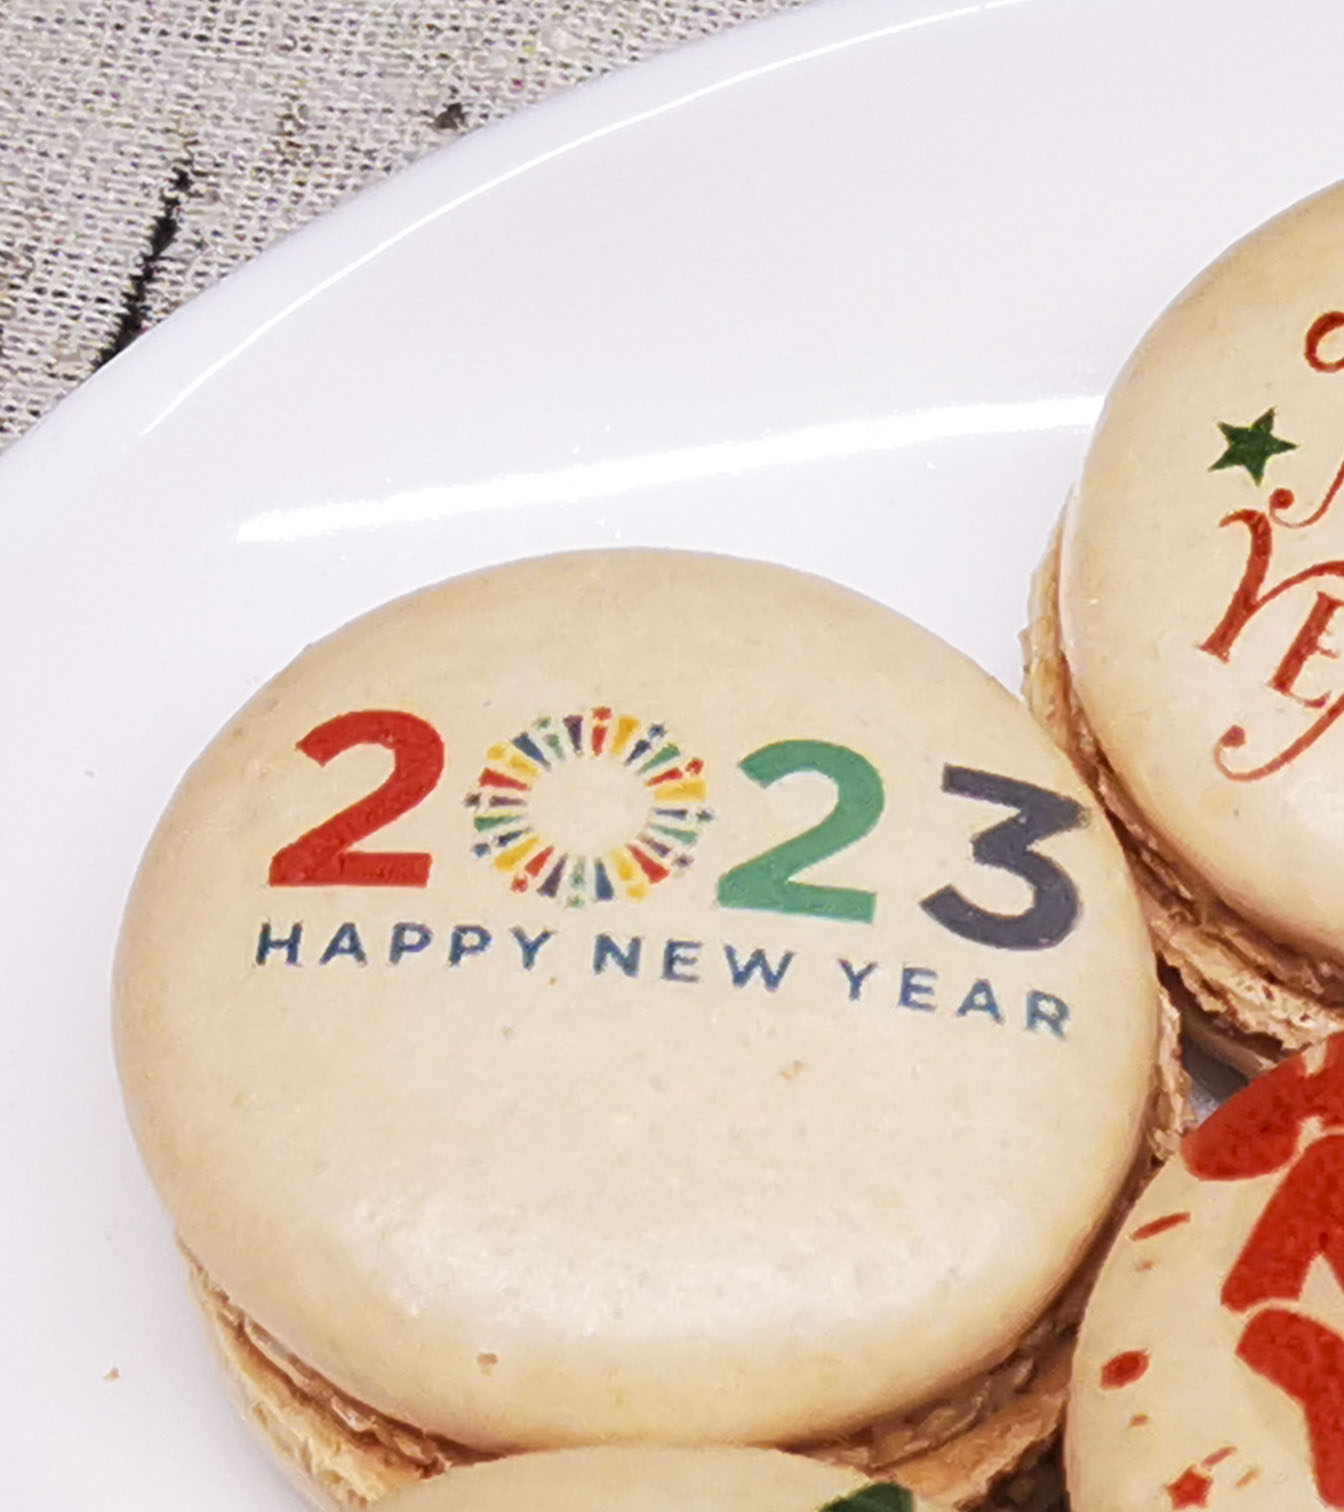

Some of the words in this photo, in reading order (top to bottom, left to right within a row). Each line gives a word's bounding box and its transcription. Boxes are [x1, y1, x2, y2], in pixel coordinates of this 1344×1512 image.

[266, 706, 1093, 951] 2023
[254, 920, 557, 973] HAPPY
[592, 931, 797, 993] NEW
[836, 956, 1075, 1041] YEAR
